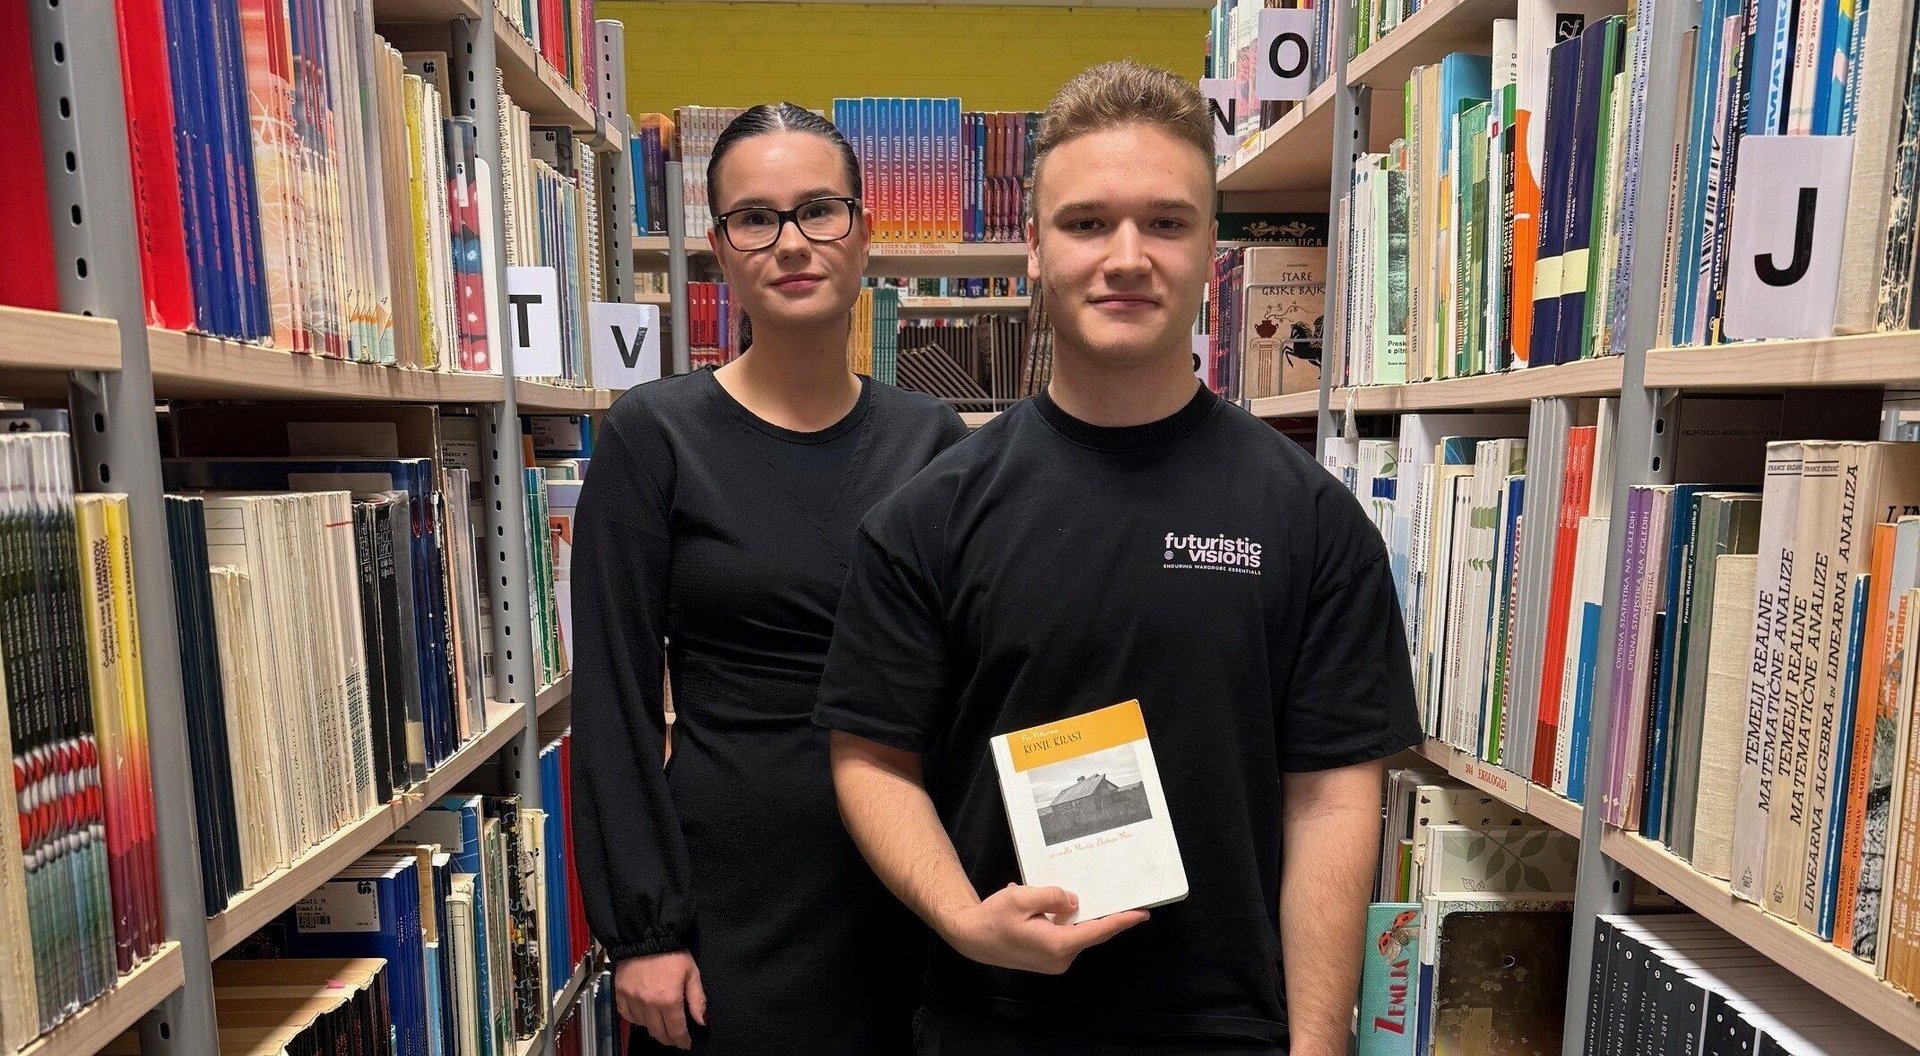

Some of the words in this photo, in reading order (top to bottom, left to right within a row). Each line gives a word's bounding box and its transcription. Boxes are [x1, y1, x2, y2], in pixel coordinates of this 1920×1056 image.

[1269, 32, 1309, 79] O
[1807, 42, 1815, 69] IMO
[1206, 98, 1236, 136] N
[880, 135, 888, 162] temah
[893, 135, 902, 162] temah
[907, 135, 916, 162] temah
[921, 135, 930, 162] temah
[936, 135, 944, 162] temah
[950, 135, 959, 162] temah
[880, 170, 888, 222] Književnost
[893, 170, 902, 222] Književnost
[907, 170, 916, 222] Književnost
[921, 170, 930, 222] Književnost
[936, 170, 944, 222] Književnost
[950, 170, 959, 222] Književnost
[1667, 193, 1676, 234] MNOŽICE
[1754, 187, 1818, 287] J
[1281, 271, 1312, 282] STARE
[1623, 244, 1632, 282] Pregled
[1663, 236, 1672, 289] KONVEKSNE
[1262, 286, 1295, 296] GRSKE
[509, 294, 542, 348] T
[1463, 297, 1471, 344] OKOLJE
[610, 325, 648, 369] V
[1165, 532, 1262, 556] futuristic
[1627, 510, 1637, 553] ZGLEDIH
[1640, 511, 1650, 556] ZGLEDIH
[93, 540, 104, 603] ELEMENTOV
[100, 538, 110, 600] ELEMENTOV
[122, 535, 132, 596] ELEMENTOV
[1188, 549, 1261, 568] visions
[1194, 564, 1227, 572] WARDROBE
[1228, 566, 1261, 575] ESSENTIALS
[1625, 558, 1632, 573] NA
[1637, 560, 1645, 575] NA
[1620, 576, 1630, 628] STATISTIKA
[1632, 577, 1643, 630] STATISTIKA
[1615, 630, 1625, 669] OPISNA
[1627, 632, 1637, 671] OPISNA
[1753, 591, 1773, 677] REALNE
[1787, 596, 1807, 687] REALNE
[1758, 649, 1785, 814] MATEMATIČNE
[1775, 548, 1794, 645] ANALIZE
[1790, 657, 1818, 828] MATEMATIČNE
[1808, 552, 1829, 652] ANALIZE
[1804, 806, 1823, 914] LINEARNA
[1815, 702, 1835, 802] ALGEBRA
[1826, 571, 1848, 683] LINEARNA
[1838, 464, 1859, 564] ANALIZA
[1745, 681, 1766, 765] TEMELJI
[1779, 689, 1798, 777] TEMELJI
[1023, 740, 1053, 755] KONJE
[1464, 762, 1474, 776] 504
[1477, 769, 1508, 792] EKOLOGIJA
[1374, 959, 1410, 1035] ZEMLJA
[1661, 1014, 1669, 1037] 2014
